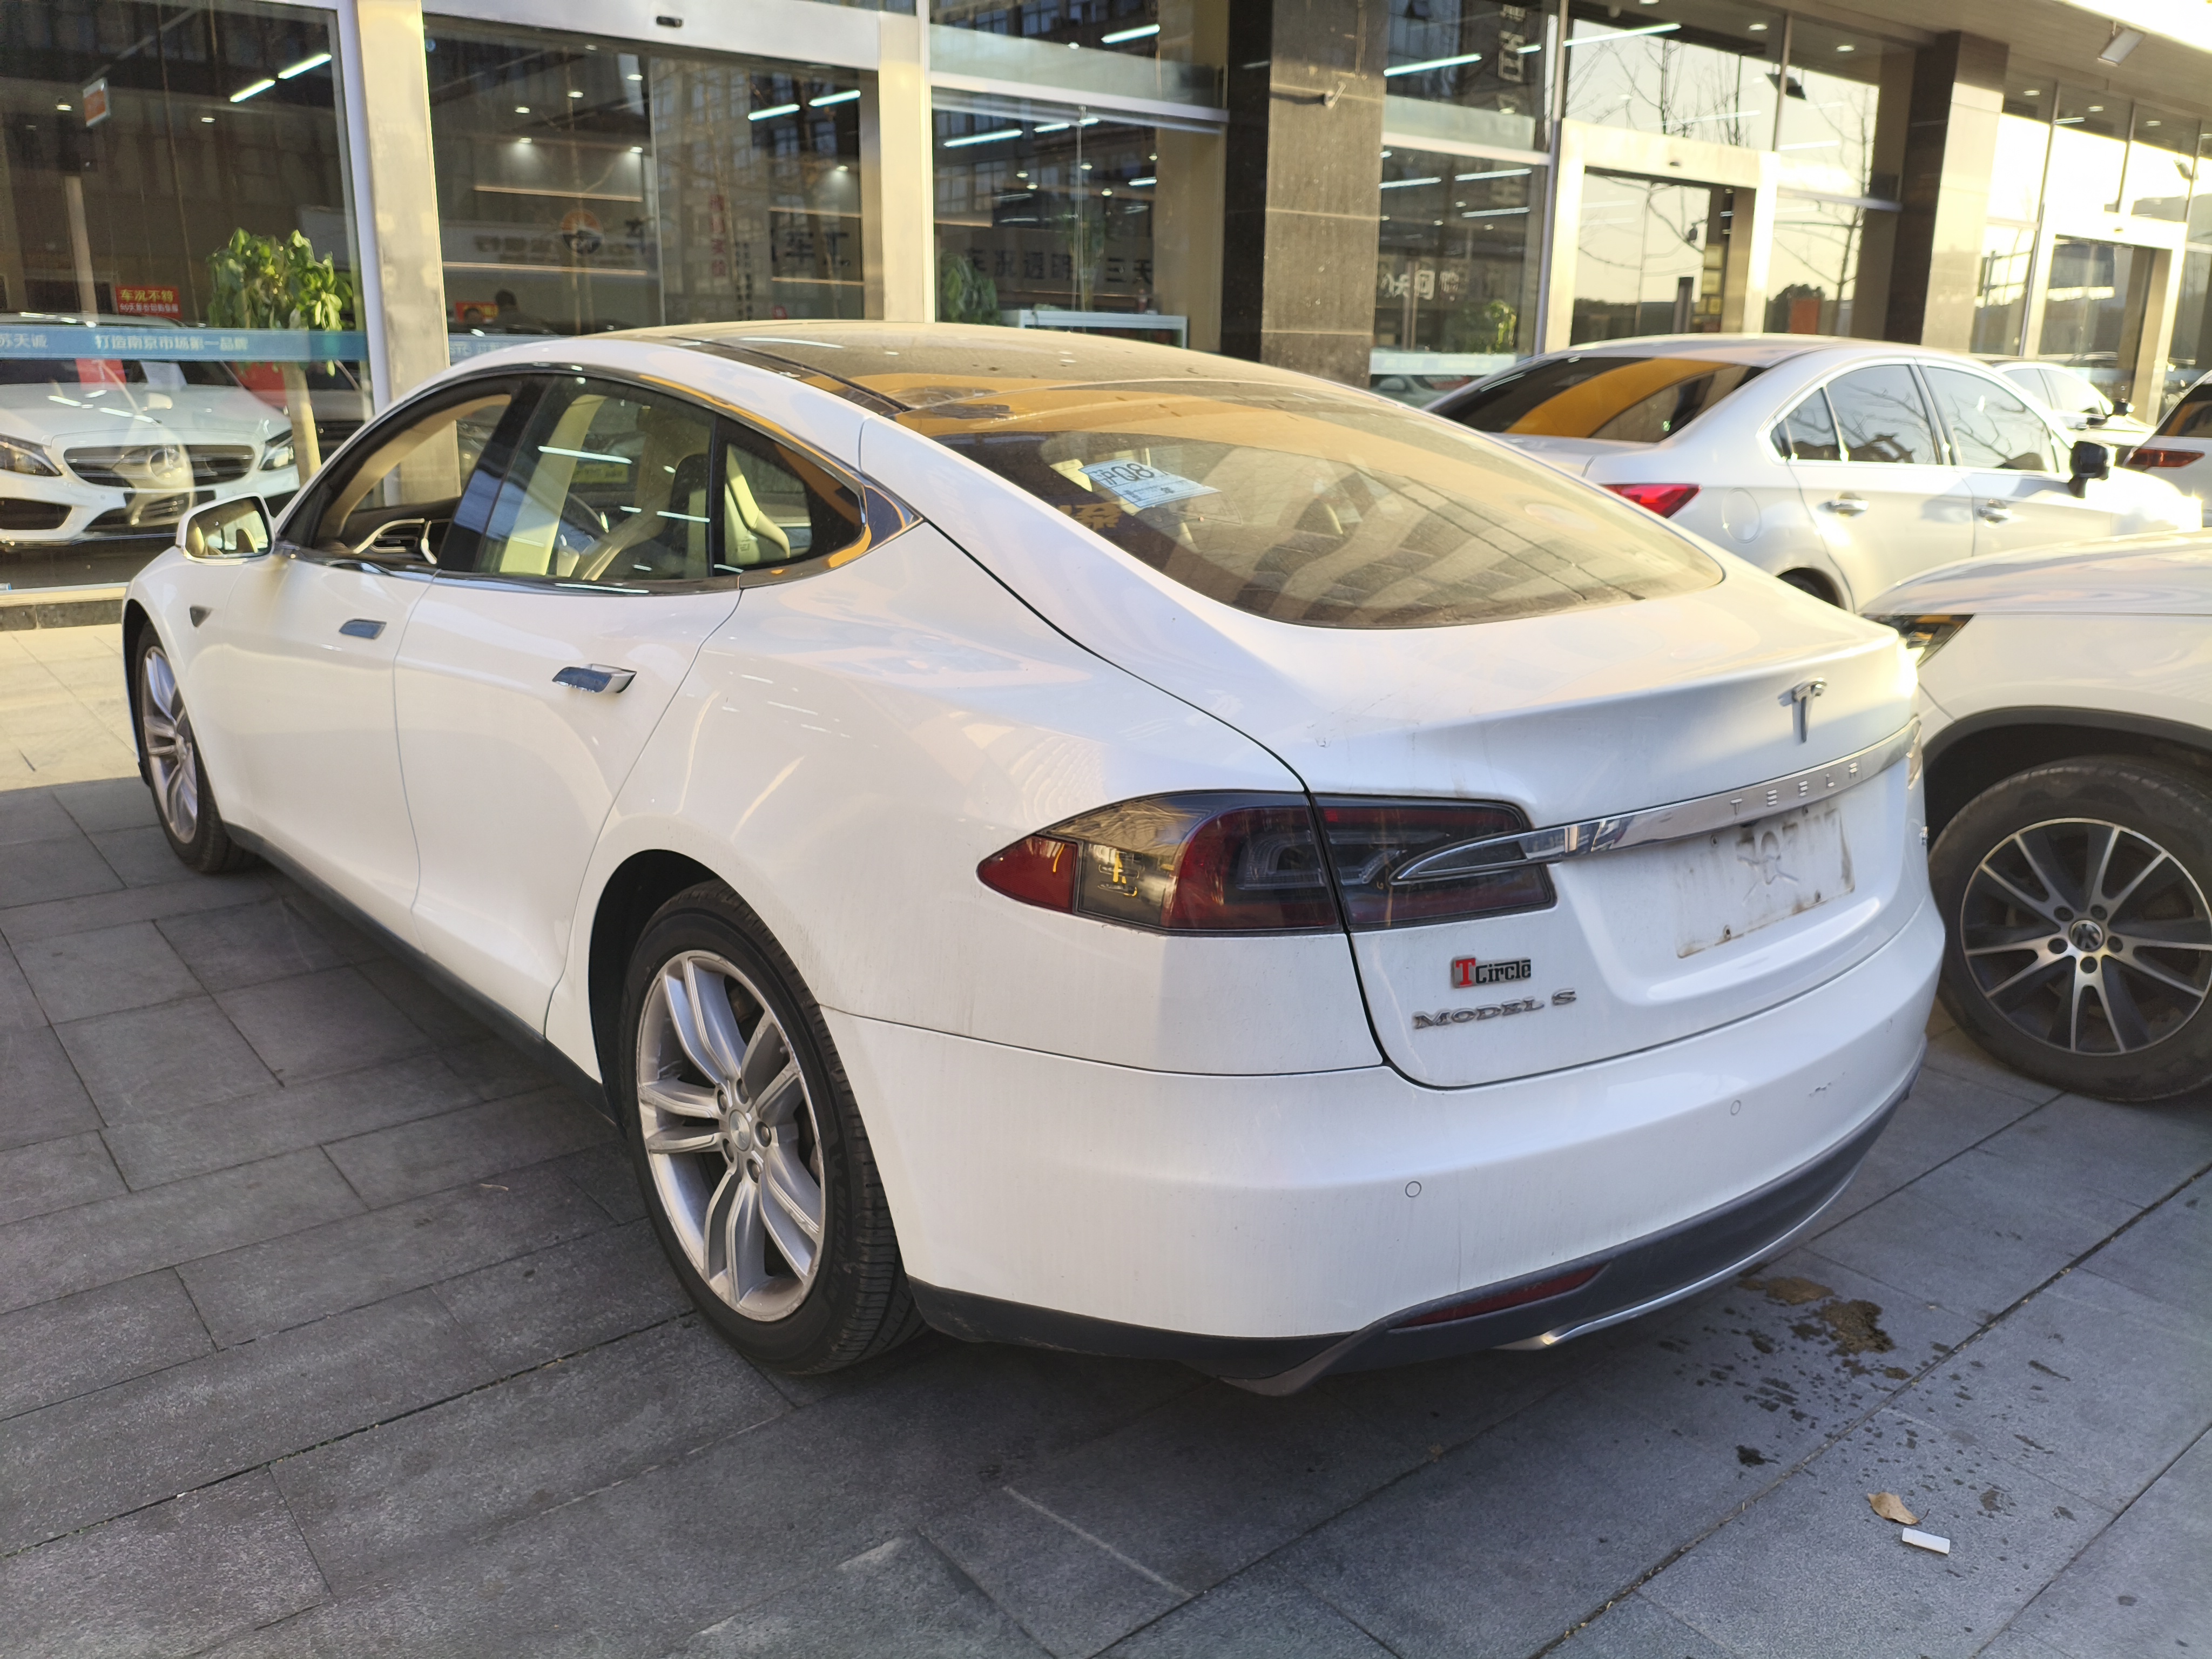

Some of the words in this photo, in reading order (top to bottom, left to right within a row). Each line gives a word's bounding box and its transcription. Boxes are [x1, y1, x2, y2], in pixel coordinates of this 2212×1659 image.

[95, 335, 248, 351] 打造南京市场第一品牌
[1730, 761, 1858, 815] TESLA
[1413, 996, 1545, 1029] MODEL
[1551, 988, 1577, 1006] S
